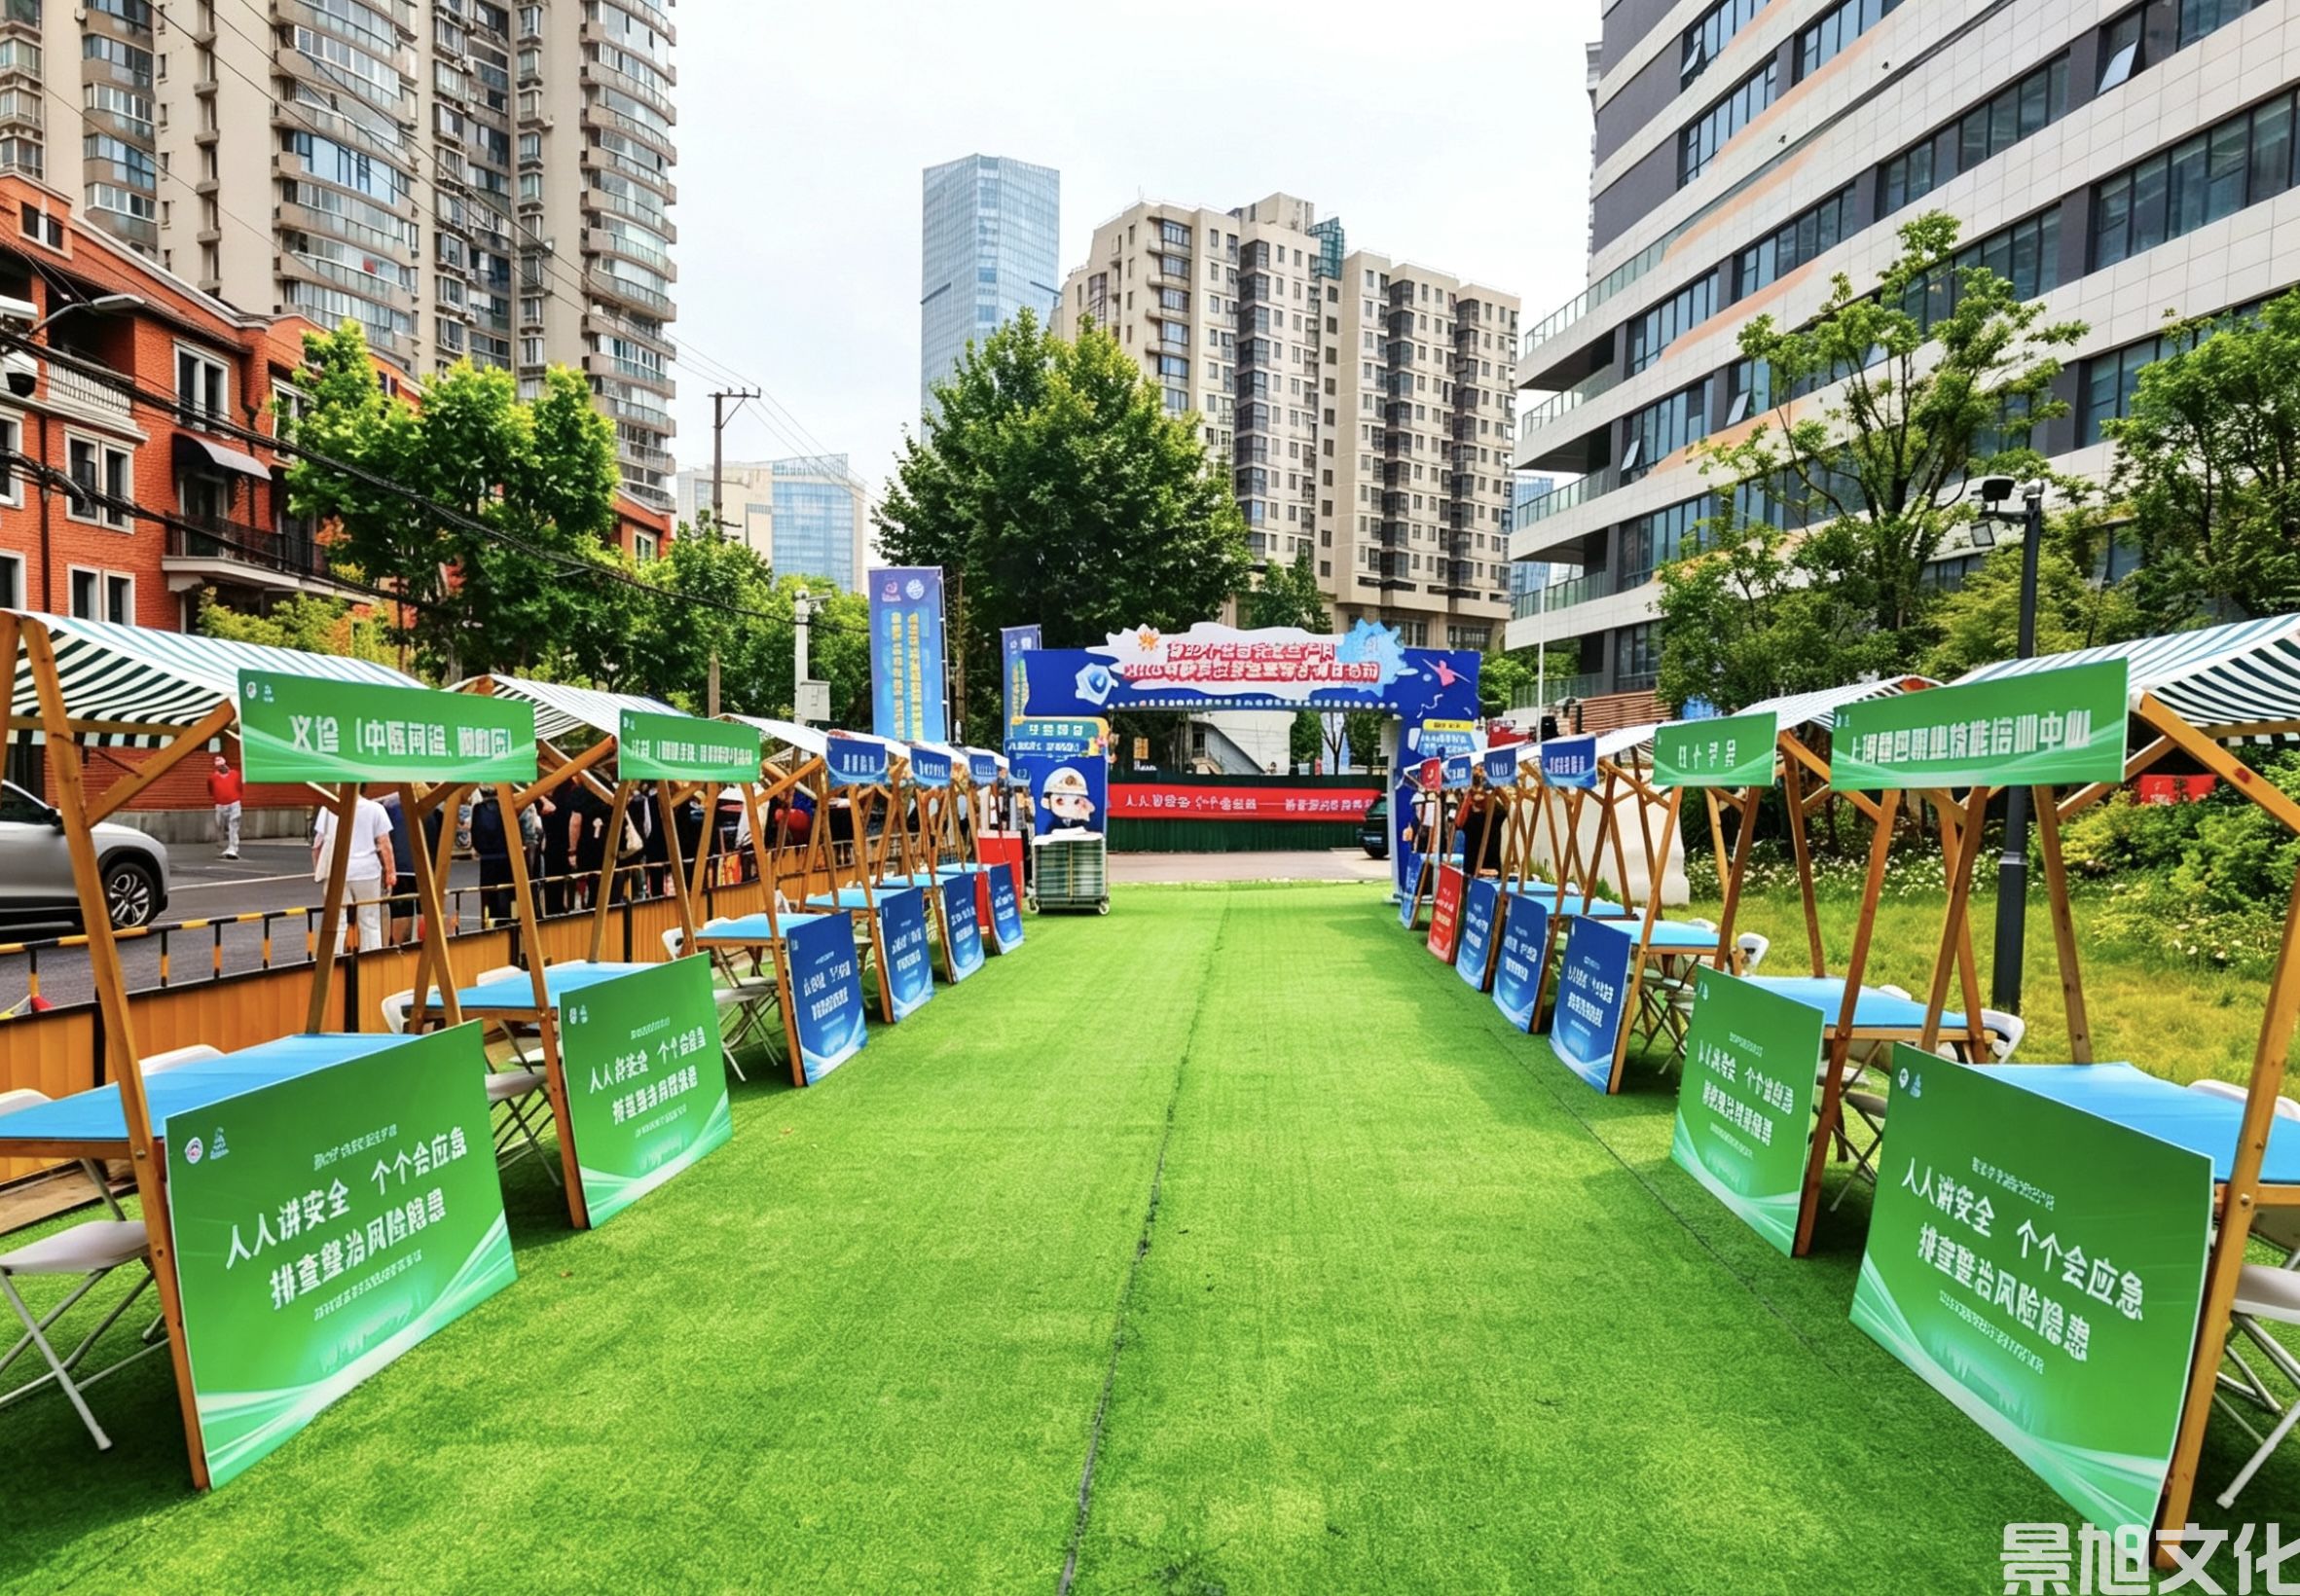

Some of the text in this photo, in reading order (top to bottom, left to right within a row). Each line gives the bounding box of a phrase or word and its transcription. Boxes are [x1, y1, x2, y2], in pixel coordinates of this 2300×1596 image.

[226, 1178, 350, 1270] 人人讲安全
[371, 1126, 467, 1196] 个个会应急
[1902, 1157, 1995, 1238] 人人讲安全
[2016, 1218, 2143, 1322] 个个会应急
